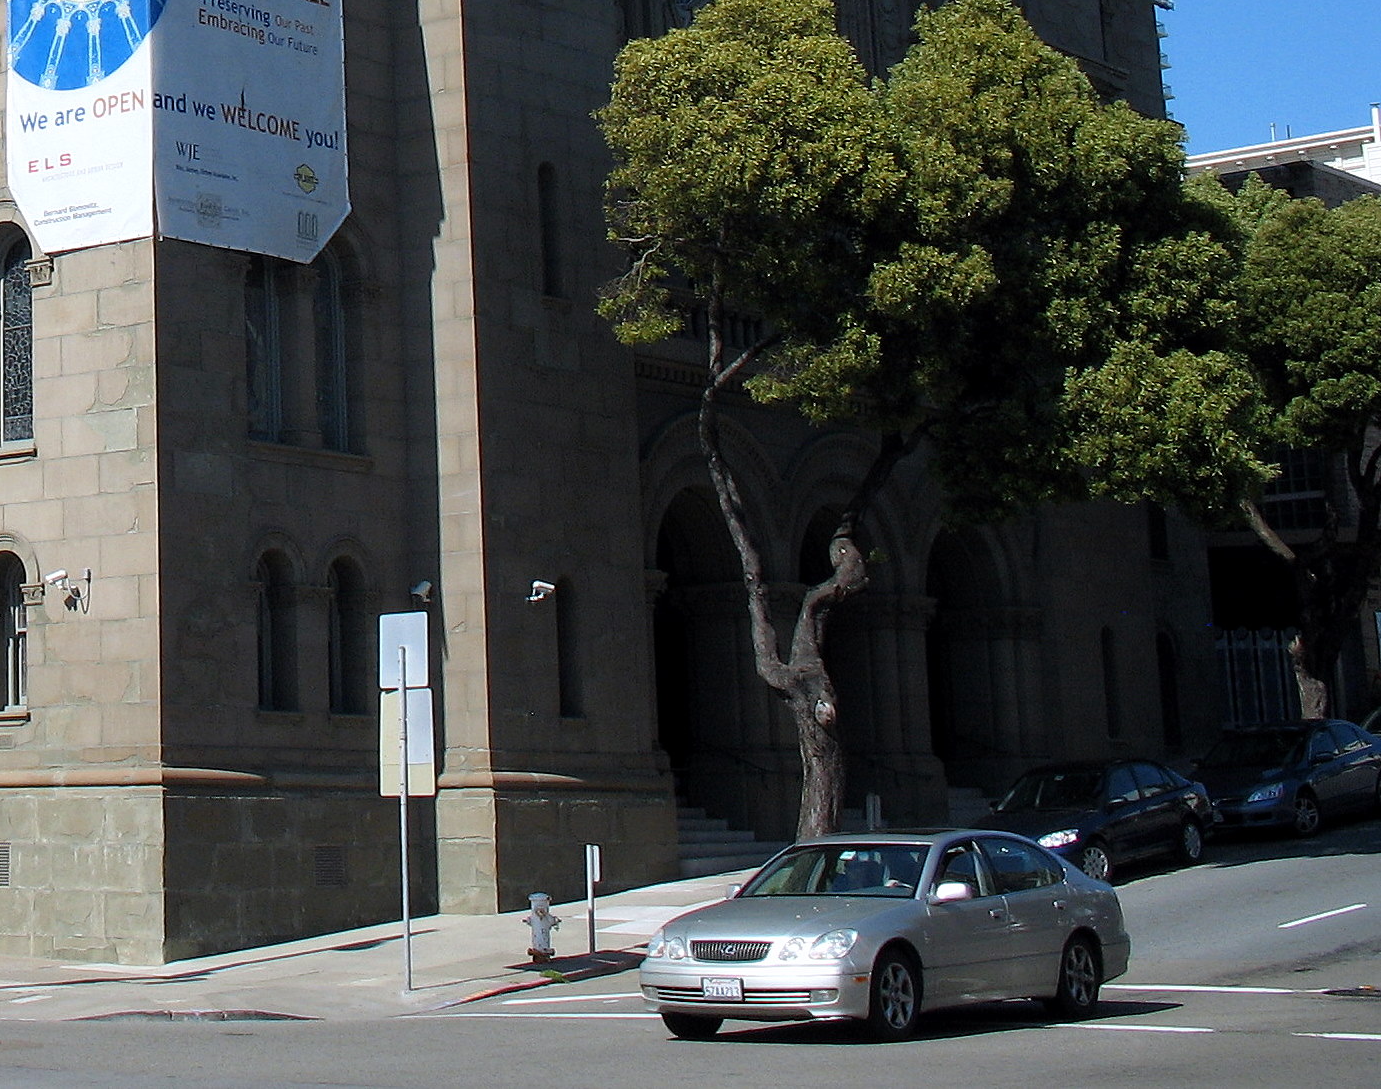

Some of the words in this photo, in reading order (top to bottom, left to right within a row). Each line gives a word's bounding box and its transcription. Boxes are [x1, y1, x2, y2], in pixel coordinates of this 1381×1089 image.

[198, 8, 266, 45] Embracing
[267, 31, 285, 46] Our
[288, 36, 319, 55] Future
[275, 14, 292, 29] Our
[20, 112, 48, 133] We
[54, 107, 86, 126] are
[92, 90, 145, 118] OPEN
[153, 93, 186, 114] and
[193, 101, 216, 121] we
[220, 102, 301, 142] WELCOME
[305, 128, 339, 151] you!
